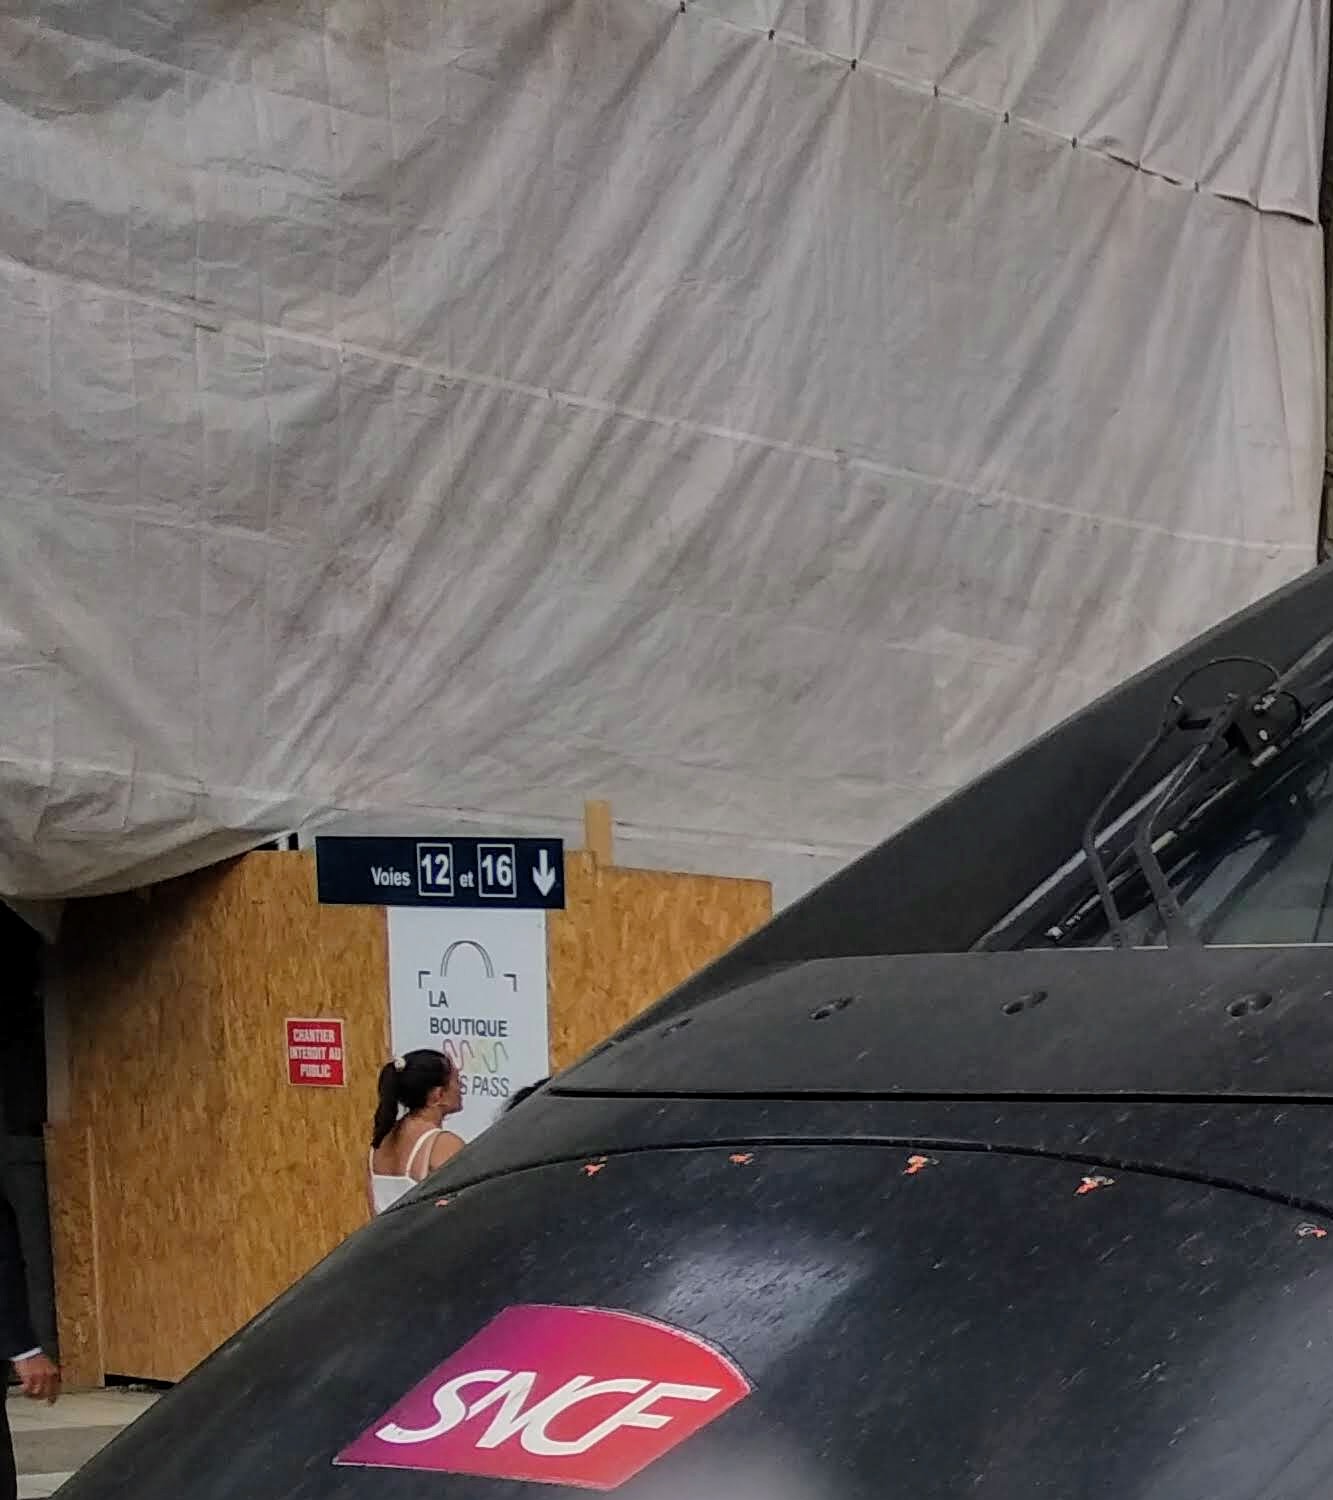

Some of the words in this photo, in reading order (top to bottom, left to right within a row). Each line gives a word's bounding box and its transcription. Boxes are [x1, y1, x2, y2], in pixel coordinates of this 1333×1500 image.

[371, 866, 411, 887] Voies
[421, 853, 451, 886] 12
[459, 871, 475, 888] et
[482, 854, 512, 887] 16
[428, 990, 449, 1009] LA
[292, 1028, 336, 1044] CHANTIER
[429, 1016, 509, 1038] BOUTIQUE
[328, 1047, 342, 1061] AU
[300, 1063, 332, 1078] PUBLIC
[471, 1075, 510, 1098] PASS
[375, 1368, 722, 1457] SNCF
